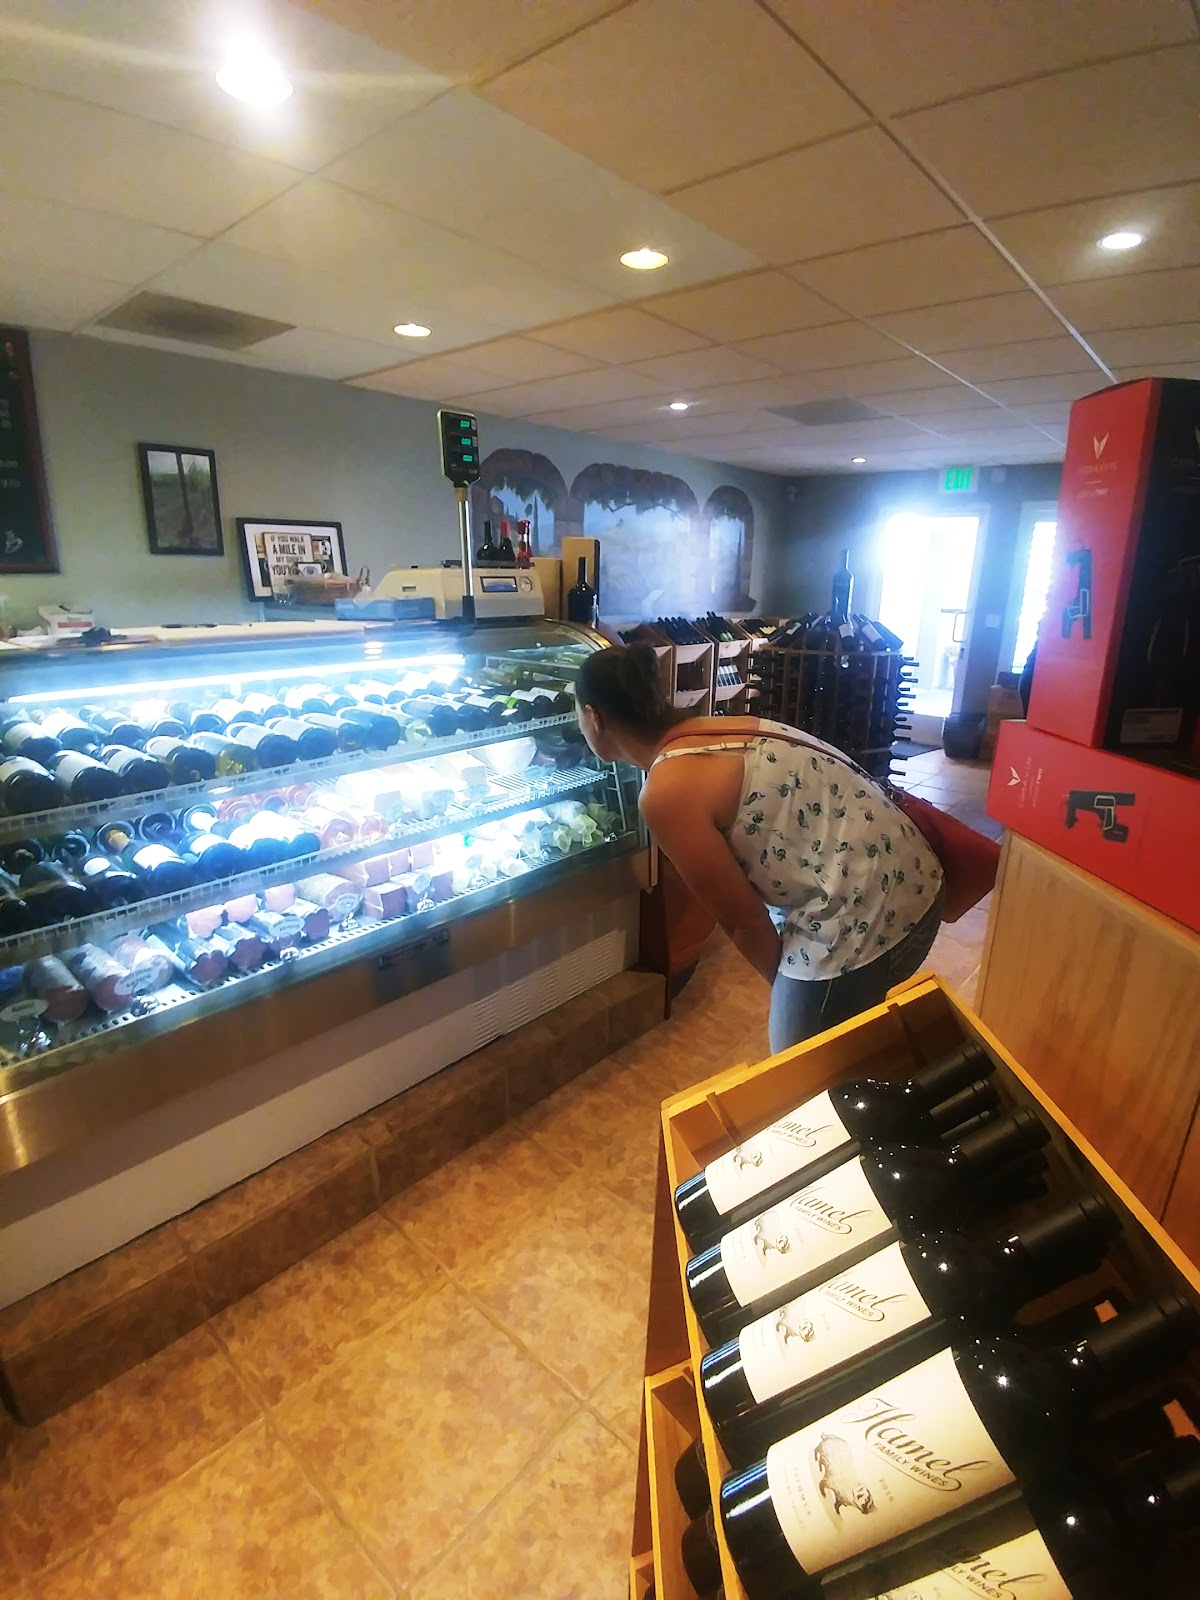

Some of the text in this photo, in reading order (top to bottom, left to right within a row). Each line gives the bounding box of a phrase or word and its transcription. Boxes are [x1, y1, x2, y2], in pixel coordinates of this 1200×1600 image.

[945, 467, 973, 491] EXIT
[273, 543, 306, 555] A MILE IN
[766, 1116, 835, 1148] amel
[817, 1216, 842, 1231] WINES
[846, 1300, 875, 1318] WINES
[842, 1398, 992, 1492] Hamel
[873, 1442, 948, 1487] FAMILY WINES
[879, 1477, 896, 1503] 2016
[965, 1573, 1004, 1599] WINES
